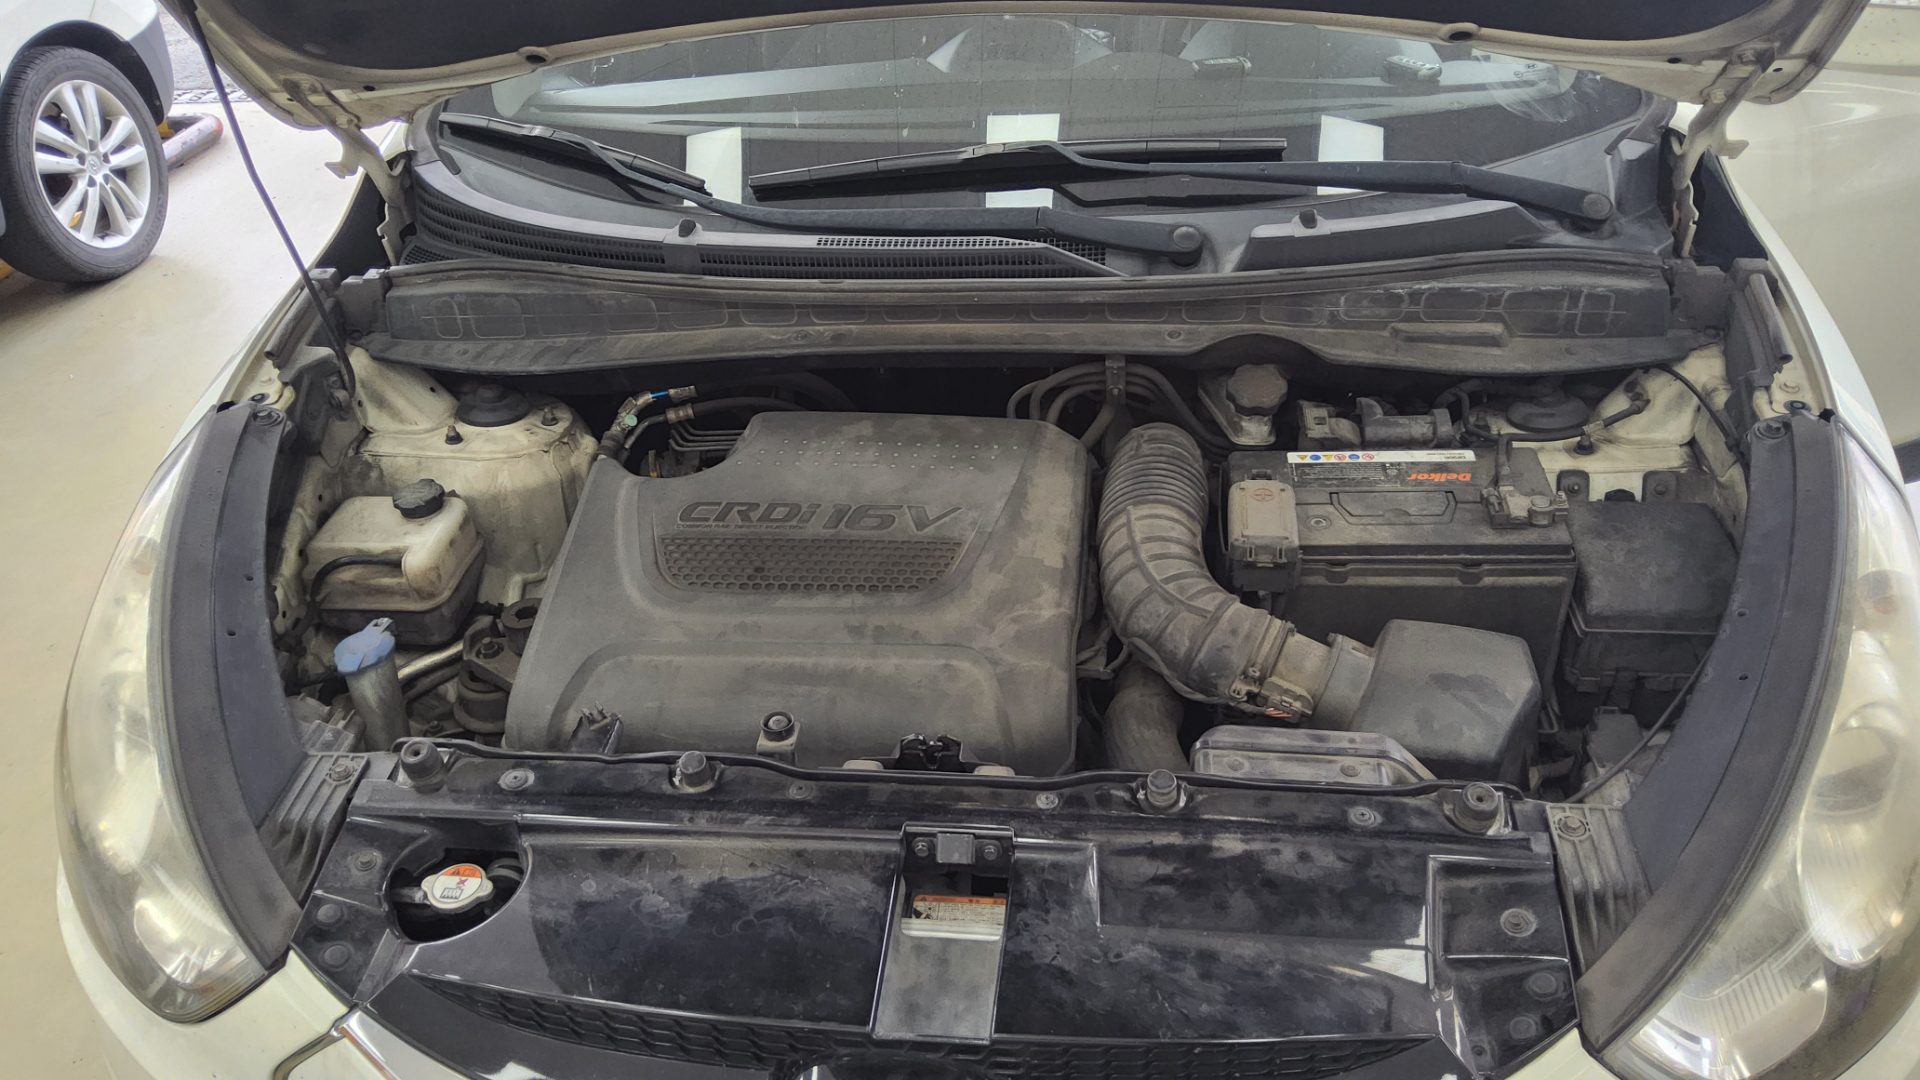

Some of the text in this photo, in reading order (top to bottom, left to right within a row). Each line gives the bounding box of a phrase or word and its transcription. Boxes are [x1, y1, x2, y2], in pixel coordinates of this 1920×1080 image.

[1408, 472, 1472, 482] Delkor
[678, 501, 964, 533] CRDi 16V
